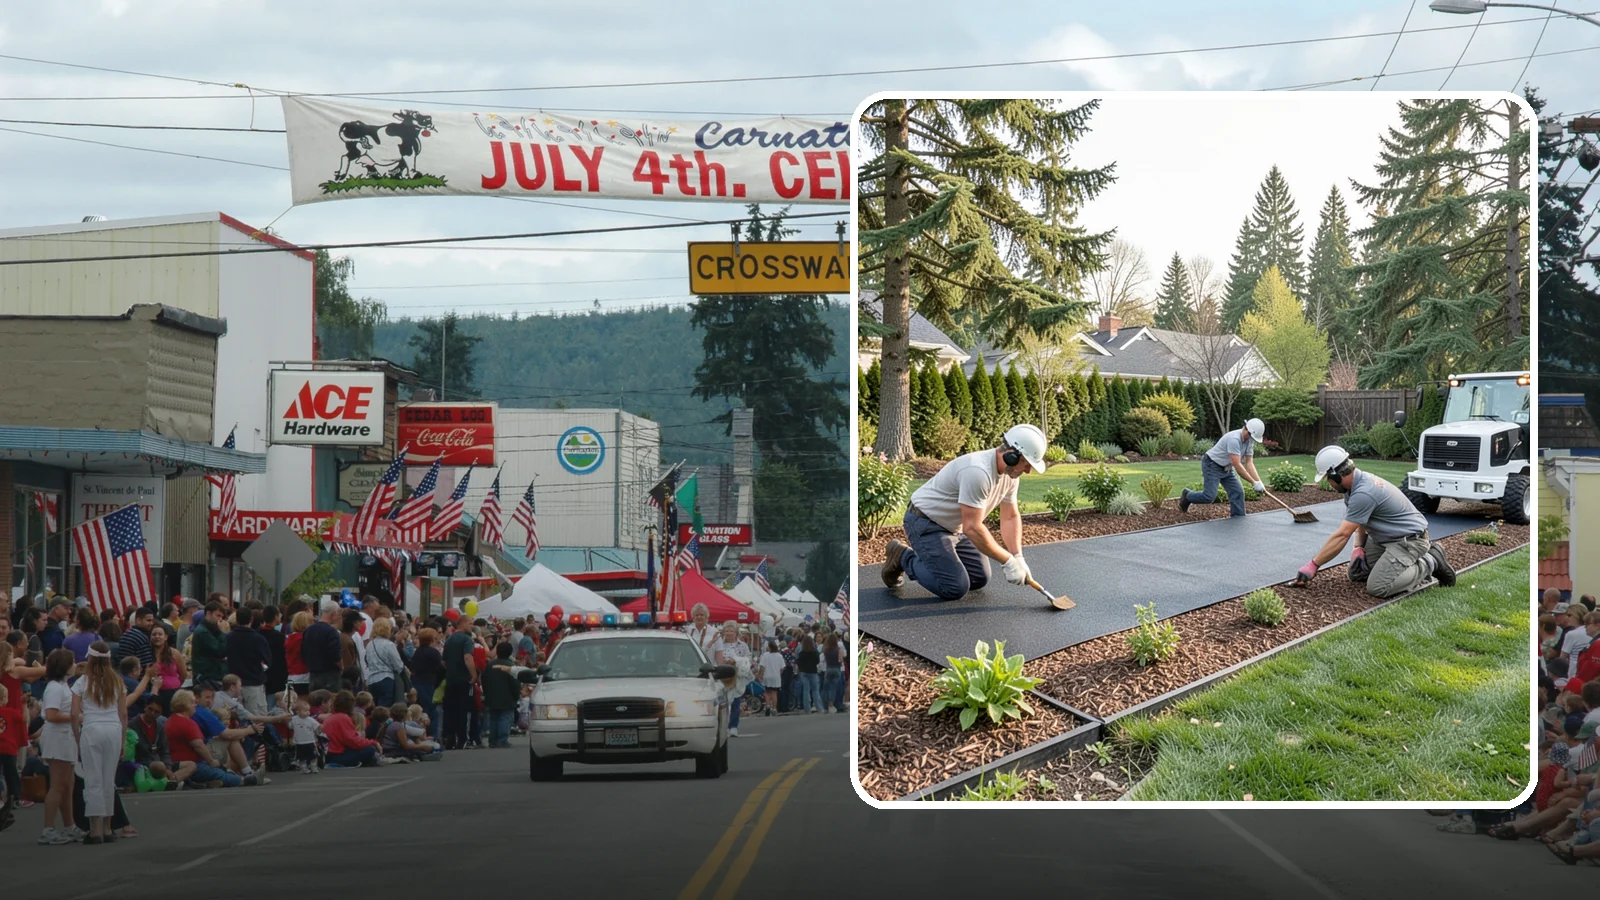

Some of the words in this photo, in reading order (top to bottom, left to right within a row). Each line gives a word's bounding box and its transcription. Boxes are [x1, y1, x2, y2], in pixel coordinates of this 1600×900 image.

[695, 121, 850, 149] Carnat
[481, 141, 605, 192] JULY
[632, 150, 746, 197] 4th.
[697, 254, 850, 279] CROSSWA
[282, 380, 373, 420] ACE
[405, 410, 452, 422] CEDAR
[283, 421, 370, 436] Hardware
[416, 428, 477, 447] Coca-Cola
[353, 467, 385, 480] Simpl
[95, 485, 124, 494] Vincent
[126, 486, 136, 495] de
[138, 486, 155, 495] Paul
[688, 527, 741, 535] CRNATION
[699, 535, 730, 543] GLASS
